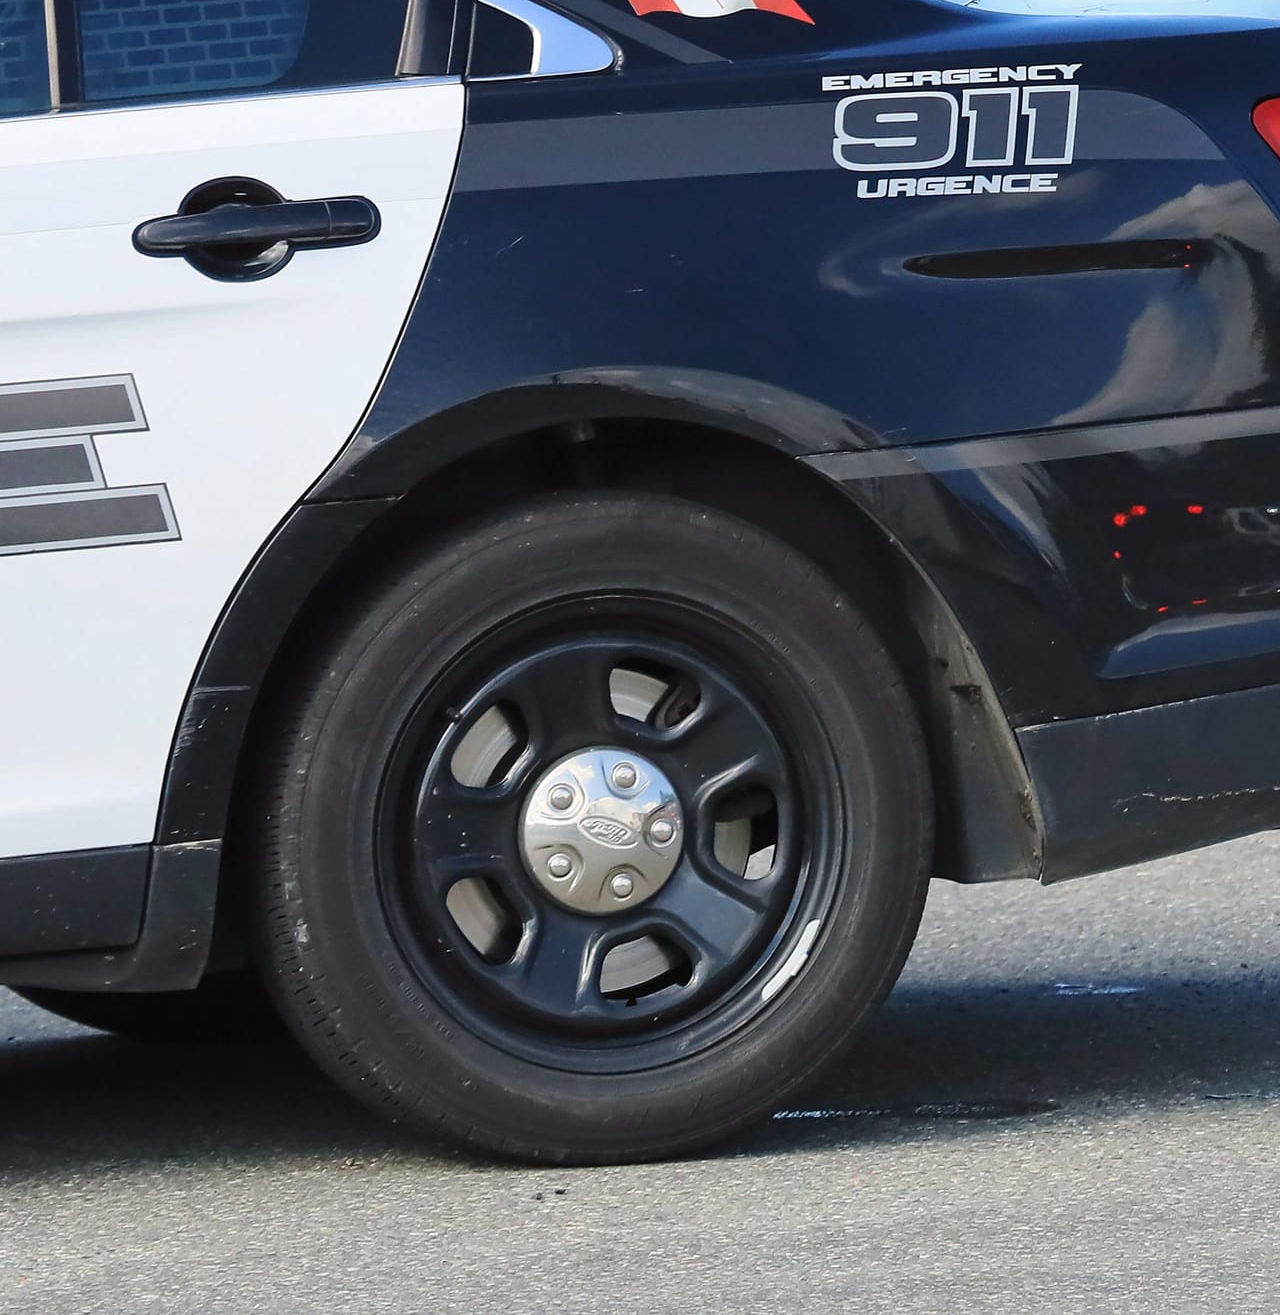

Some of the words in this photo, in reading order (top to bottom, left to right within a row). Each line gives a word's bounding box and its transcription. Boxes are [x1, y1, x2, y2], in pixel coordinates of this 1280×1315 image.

[821, 63, 1083, 92] EMERGENCY
[832, 84, 1079, 172] 911
[856, 172, 1058, 199] URGENCE
